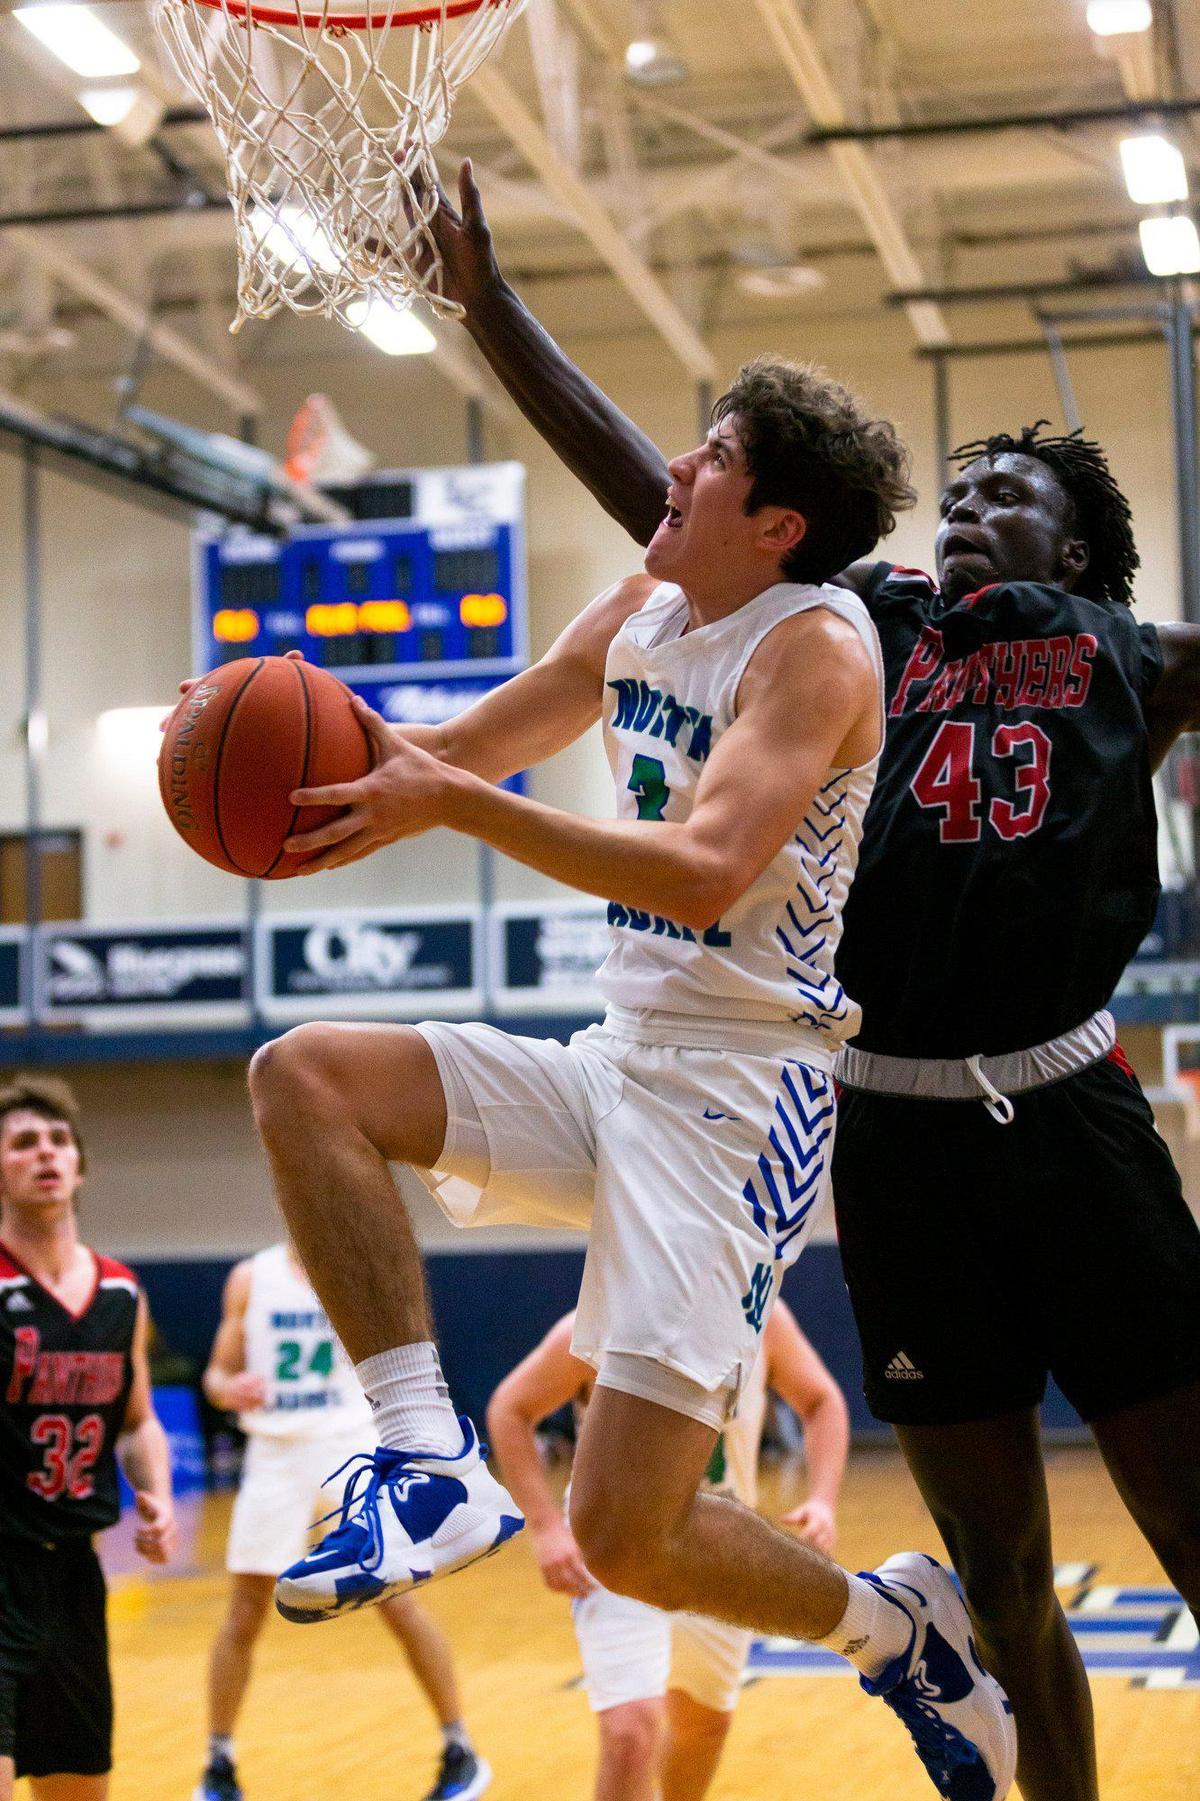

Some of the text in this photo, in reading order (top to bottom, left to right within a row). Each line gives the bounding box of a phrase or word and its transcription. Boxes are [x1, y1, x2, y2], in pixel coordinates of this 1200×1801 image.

[887, 624, 1098, 718] PANTHERS
[170, 683, 222, 831] SPALDING
[909, 720, 1052, 843] 43
[276, 1340, 334, 1381] 24
[884, 1367, 925, 1381] adidas
[27, 1413, 106, 1500] 32
